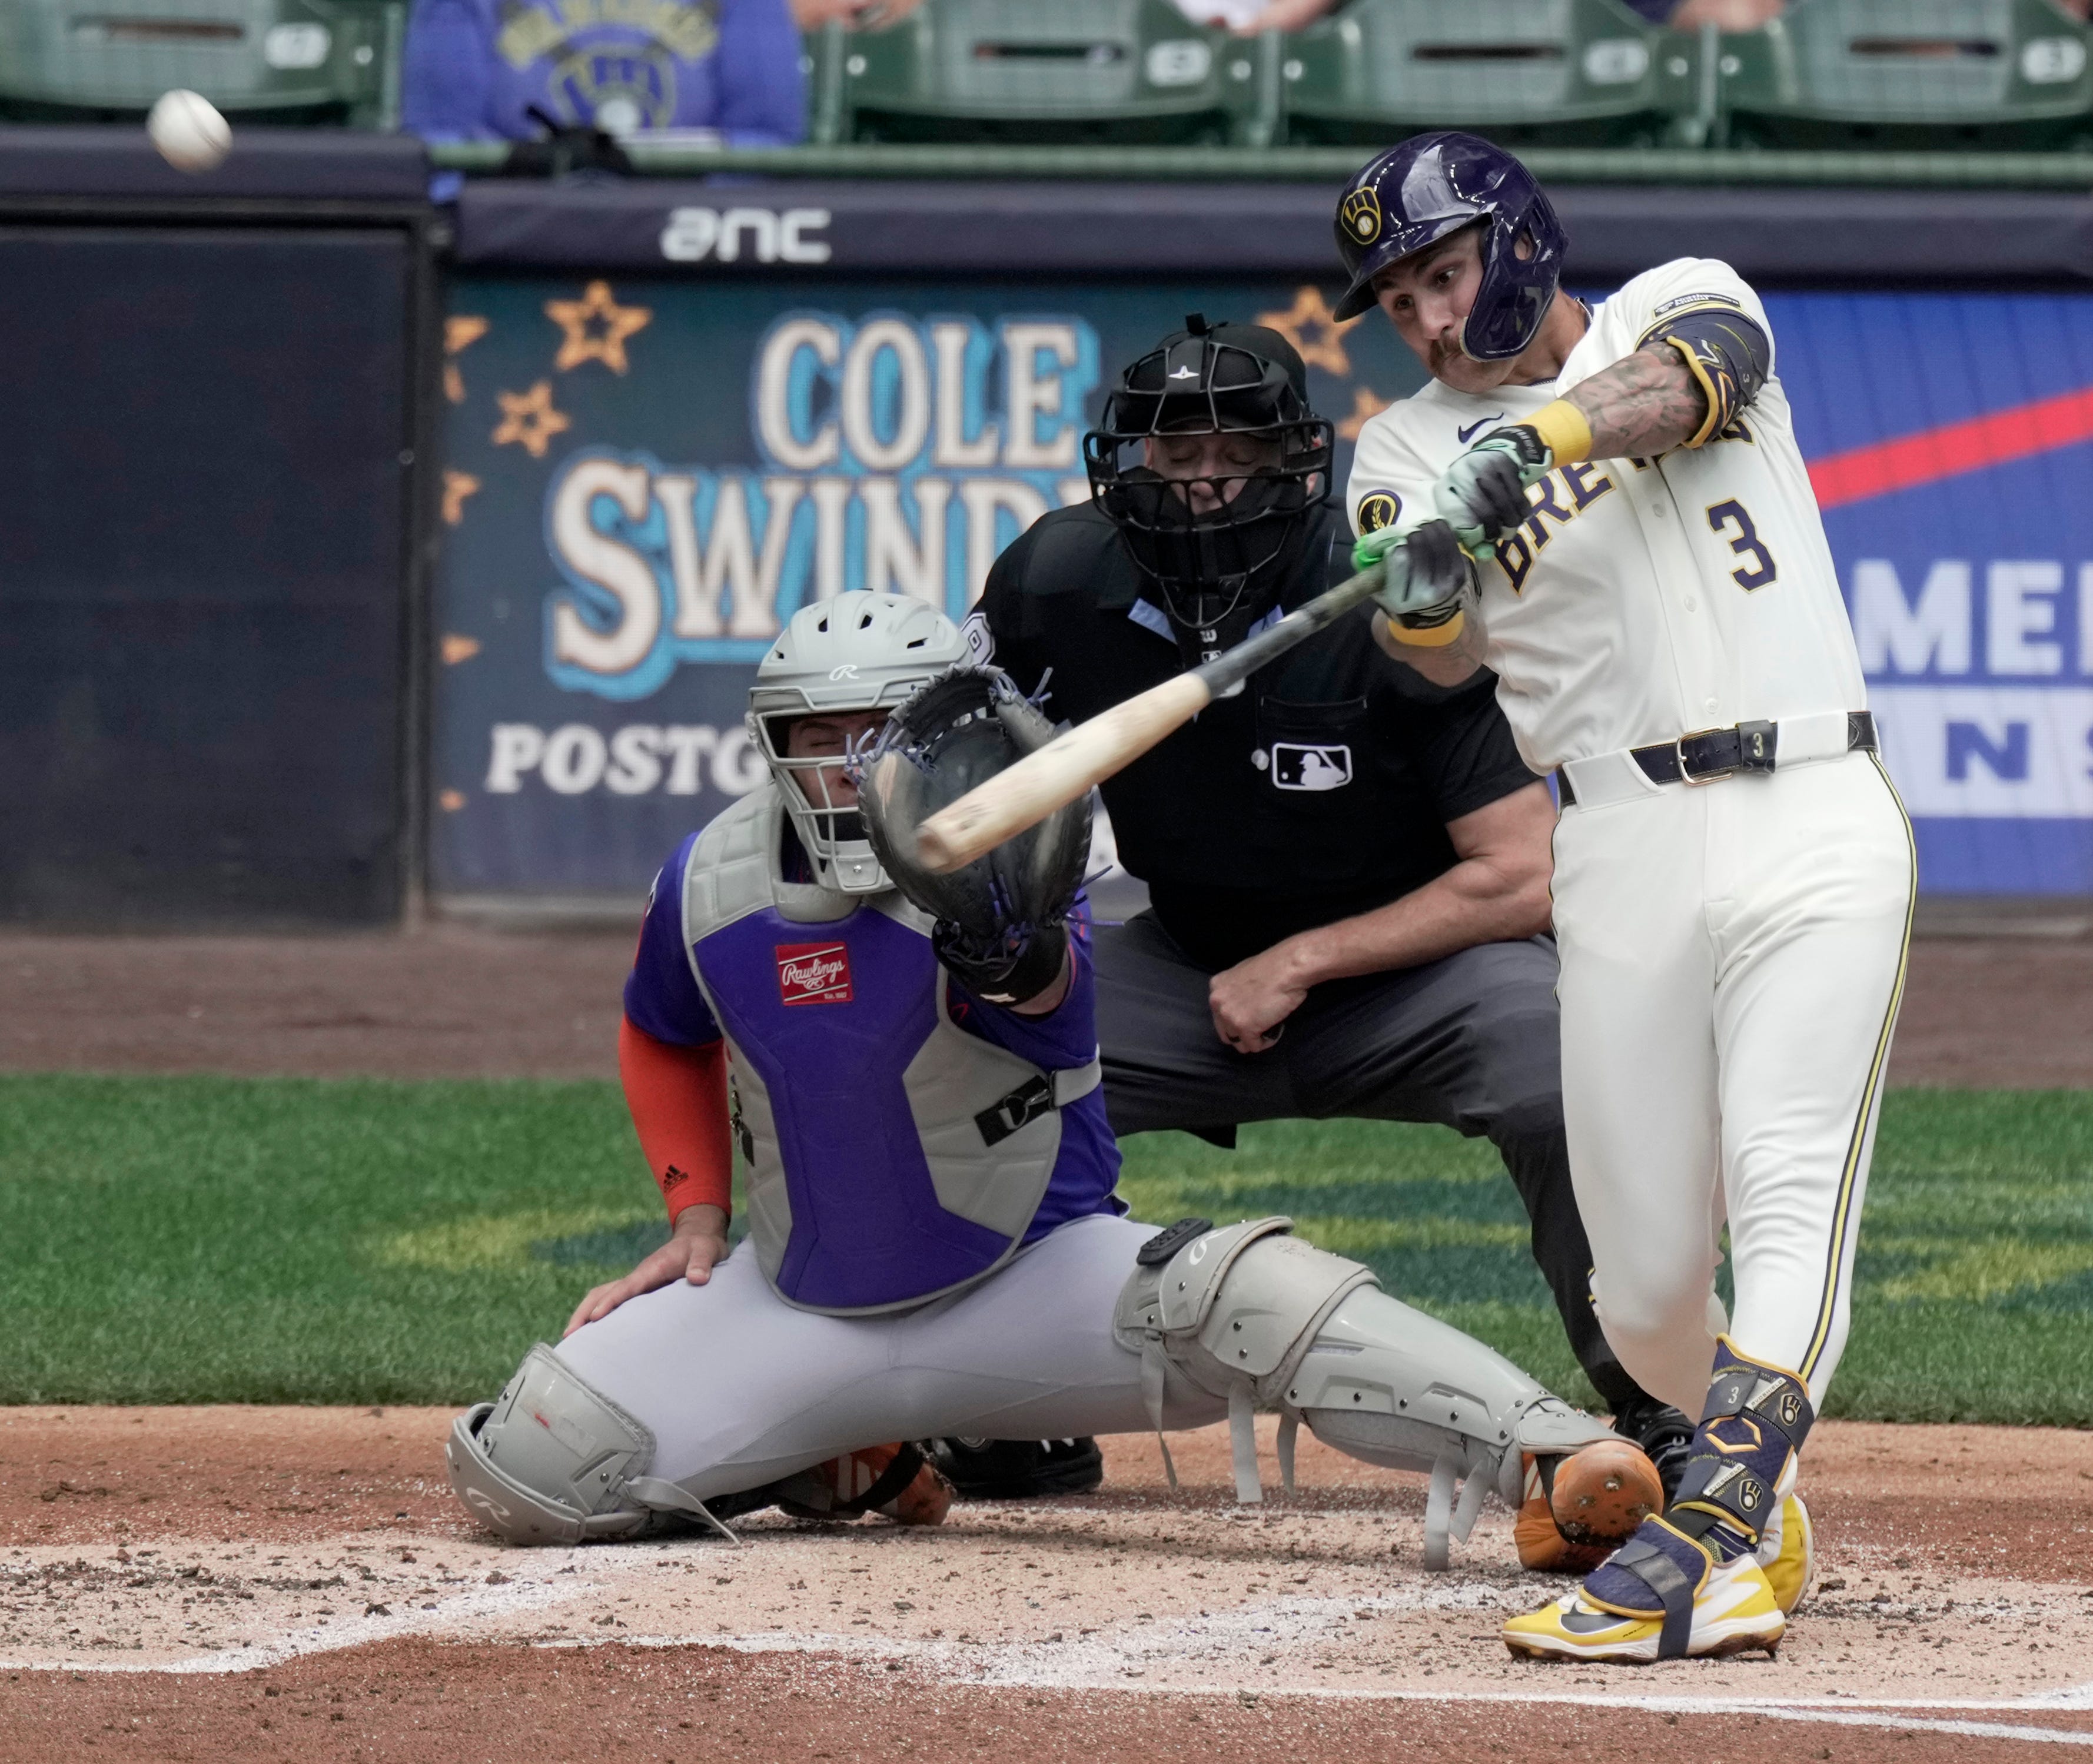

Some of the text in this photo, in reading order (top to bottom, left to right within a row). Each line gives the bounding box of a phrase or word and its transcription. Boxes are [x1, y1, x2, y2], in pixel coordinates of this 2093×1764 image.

[660, 207, 832, 264] anc
[758, 318, 1079, 469] COLE
[552, 457, 1093, 673] SWIND
[1706, 497, 1778, 594] 3
[1853, 559, 2093, 675] ME
[485, 723, 773, 795] POSTG
[1753, 732, 1763, 758] 3
[782, 958, 846, 986] Rawlings
[1727, 1386, 1739, 1404] 3
